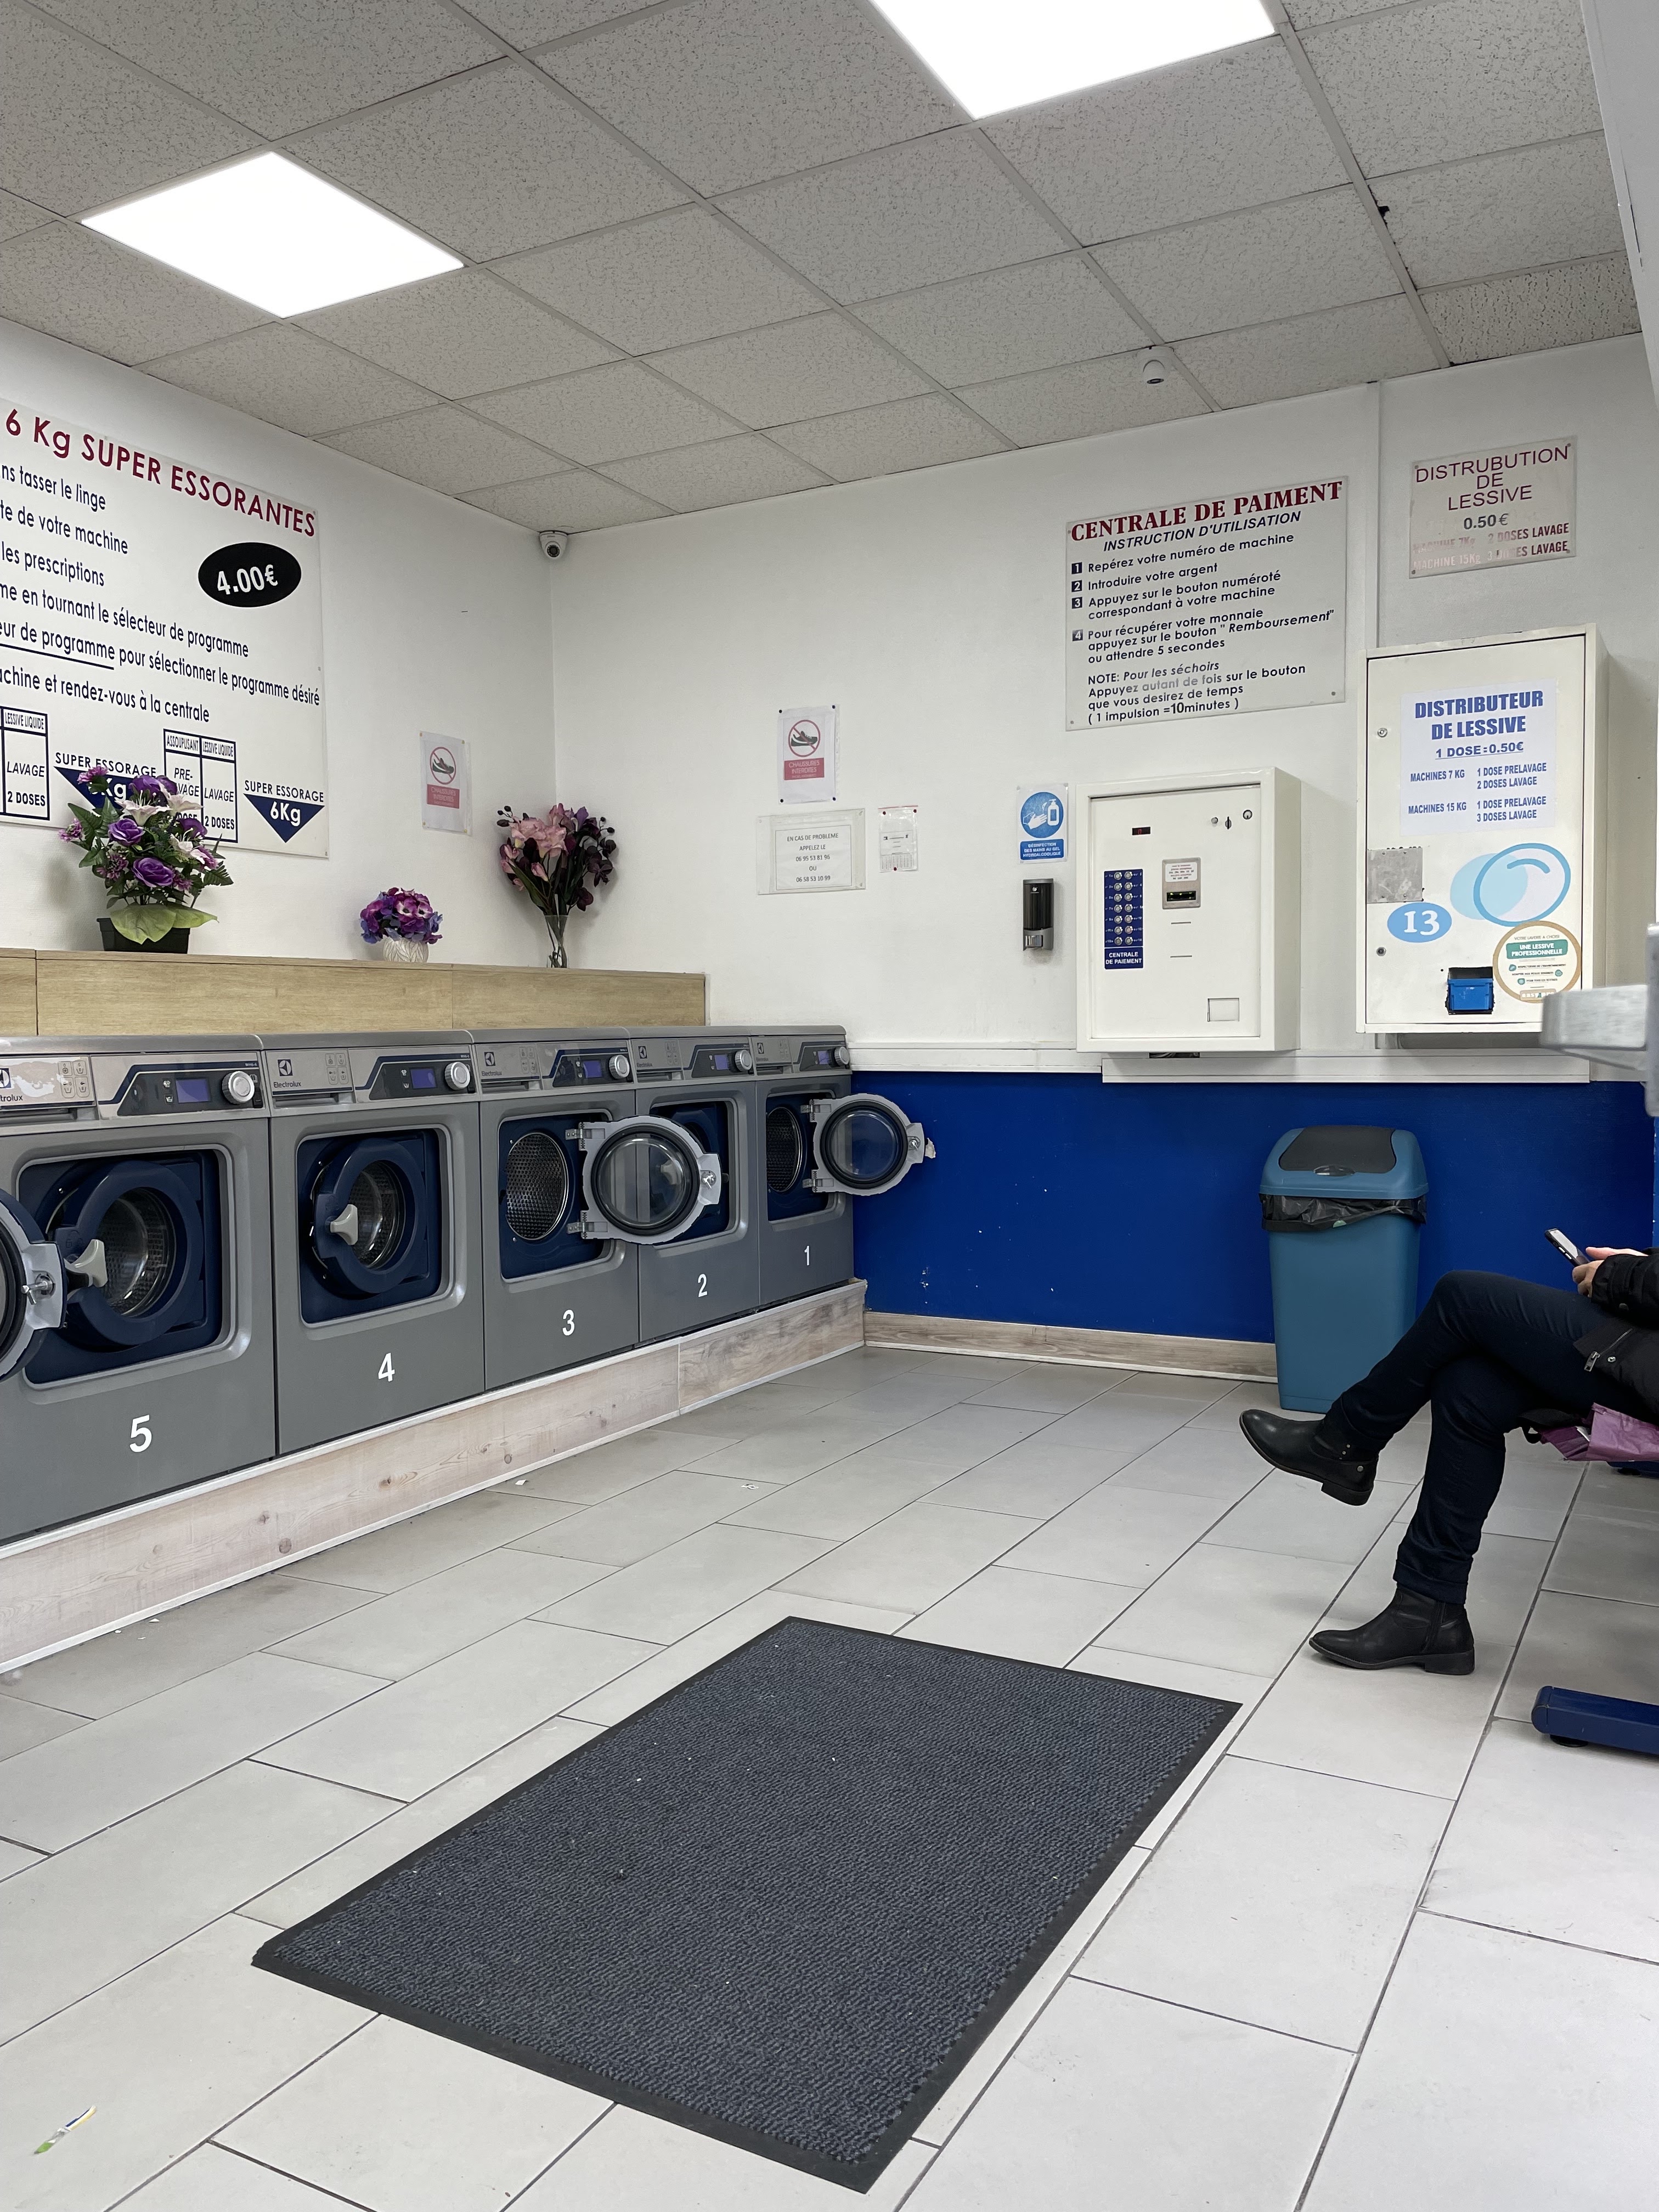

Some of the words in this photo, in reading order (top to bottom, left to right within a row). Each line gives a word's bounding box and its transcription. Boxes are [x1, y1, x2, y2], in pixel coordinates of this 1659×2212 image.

[5, 408, 21, 436] 6
[33, 416, 70, 459] Kg
[81, 434, 161, 485] SUPER
[171, 465, 315, 537] ESSORANTES
[1415, 445, 1568, 484] DISTRUBUTION
[19, 465, 57, 495] tasser
[61, 478, 72, 500] le
[76, 483, 106, 512] linge
[1477, 472, 1504, 490] DE
[1448, 484, 1532, 511] LESSIVE
[1071, 506, 1186, 543] CENTRALE
[1194, 500, 1226, 522] DE
[1233, 481, 1342, 516] PAIMENT
[18, 506, 35, 527] de
[38, 515, 71, 538] votre
[75, 526, 128, 554] machine
[1103, 527, 1195, 552] INSTRUCTION
[1199, 511, 1301, 537] D'UTILISATION
[1532, 522, 1569, 538] LAVAGE
[1088, 558, 1133, 573] Repérez
[1137, 553, 1166, 565] votre
[1170, 545, 1215, 560] numéro
[1220, 542, 1235, 552] de
[1239, 534, 1294, 550] machine
[1531, 540, 1568, 555] LAVAGE
[2, 541, 20, 565] les
[24, 552, 104, 586] prescriptions
[217, 564, 278, 595] 4.00€
[1088, 575, 1142, 591] Introduire
[1146, 570, 1175, 582] votre
[1178, 562, 1217, 578] argent
[1088, 593, 1139, 608] Appuyez
[1142, 590, 1159, 599] sur
[1162, 587, 1172, 596] le
[1176, 582, 1218, 595] bouton
[1222, 569, 1281, 588] numéroté
[1088, 600, 1172, 620] correspondant
[1176, 597, 1183, 608] à
[1187, 595, 1217, 606] votre
[1221, 587, 1275, 602] machine
[22, 589, 38, 606] en
[42, 589, 95, 620] tournant
[98, 603, 109, 623] le
[113, 607, 166, 637] sélecteur
[170, 622, 184, 641] de
[188, 630, 249, 658] programme
[1088, 629, 1112, 640] Pour
[1115, 620, 1172, 639] récupérer
[1176, 617, 1205, 628] votre
[1210, 608, 1263, 624] monnaie
[1088, 637, 1137, 652] appuyez
[1141, 635, 1157, 644] sur
[1160, 632, 1171, 642] le
[1175, 627, 1216, 640] bouton
[1088, 655, 1102, 663] ou
[1106, 648, 1154, 662] attendre
[1158, 645, 1164, 655] 5
[1167, 639, 1225, 654] secondes
[20, 622, 37, 643] de
[42, 630, 115, 660] programme
[119, 648, 145, 667] pour
[149, 650, 216, 682] sélectionner
[218, 667, 228, 685] le
[232, 674, 289, 699] programme
[292, 684, 320, 706] désiré
[1088, 673, 1120, 685] NOTE:
[1124, 671, 1149, 681] Pour
[1151, 668, 1167, 678] les
[1171, 661, 1220, 676] séchoirs
[1088, 685, 1138, 699] Appuyez
[1142, 678, 1179, 691] autant
[1183, 676, 1198, 687] de
[1202, 673, 1222, 685] fois
[1226, 673, 1243, 682] sur
[1246, 668, 1258, 680] le
[1262, 665, 1305, 678] bouton
[45, 674, 57, 693] et
[61, 680, 136, 708] rendez-vous
[139, 690, 146, 710] à
[150, 693, 161, 713] la
[165, 701, 210, 723] centrale
[1088, 701, 1110, 712] que
[1113, 697, 1139, 707] vous
[1143, 692, 1184, 704] desirez
[1187, 689, 1203, 699] de
[1206, 686, 1243, 697] temps
[1415, 690, 1543, 719] DISTRIBUTEUR
[5, 712, 24, 726] LESSIVE
[25, 716, 44, 730] LIQUIDE
[1105, 708, 1159, 722] impulsion
[1431, 723, 1453, 740] DE
[1457, 715, 1526, 738] LESSIVE
[202, 741, 217, 754] LESSIVE
[218, 744, 233, 757] LIQUIDE
[1436, 748, 1441, 758] 1
[1447, 745, 1481, 758] DOSE
[7, 761, 45, 777] LAVAGE
[55, 752, 91, 769] SUPER
[96, 759, 156, 777] ESSORAGE
[174, 767, 193, 781] PRE-
[1410, 771, 1447, 782] MACHINES
[1448, 770, 1453, 779] 7
[1454, 769, 1465, 778] KG
[1483, 766, 1503, 776] DOSE
[1504, 762, 1547, 775] PRELAVAGE
[204, 787, 234, 802] LAVAGE
[245, 780, 273, 795] SUPER
[276, 785, 324, 803] ESSORAGE
[1483, 778, 1507, 789] DOSES
[1509, 776, 1537, 787] LAVAGE
[7, 791, 13, 803] 2
[16, 792, 46, 806] DOSES
[1408, 803, 1444, 814] MACHINES
[1446, 803, 1455, 812] 15
[1457, 802, 1466, 811] KG
[1477, 800, 1481, 810] 1
[1483, 799, 1502, 809] DOSE
[1504, 796, 1547, 808] PRELAVAGE
[205, 815, 209, 827] 2
[211, 816, 235, 830] DOSES
[270, 801, 301, 827] 6Kg
[1483, 811, 1507, 822] DOSES
[1509, 809, 1537, 820] LAVAGE
[1404, 910, 1440, 935] 13
[804, 1245, 810, 1266] 1
[697, 1273, 708, 1297] 2
[562, 1310, 575, 1336] 3
[378, 1352, 395, 1382] 4
[129, 1414, 152, 1453] 5
